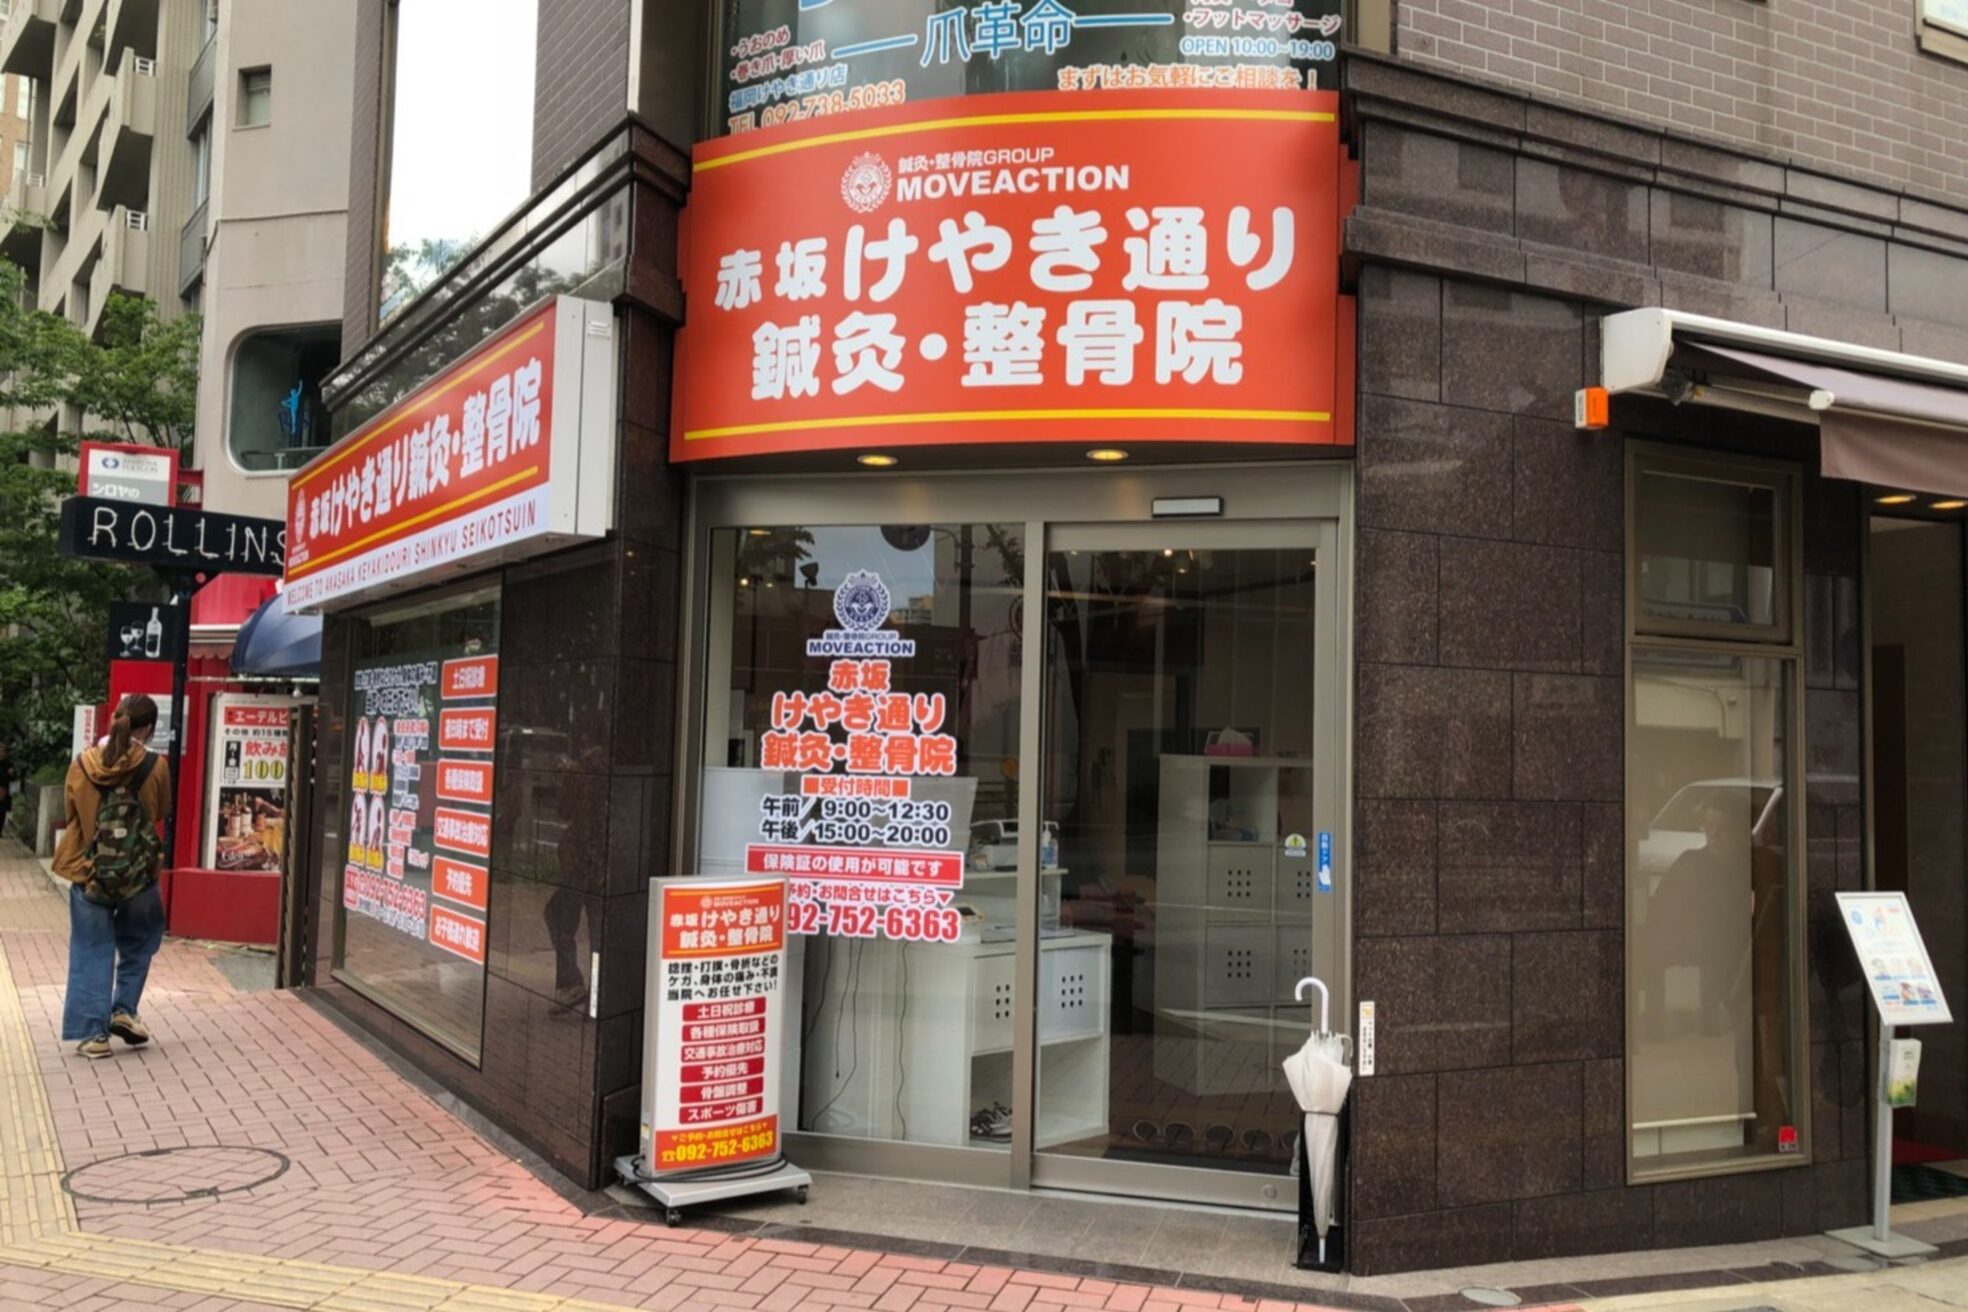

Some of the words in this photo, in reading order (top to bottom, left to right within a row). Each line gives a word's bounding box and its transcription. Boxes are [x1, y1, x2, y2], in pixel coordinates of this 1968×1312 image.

[919, 0, 1074, 67] 爪革命
[1180, 37, 1229, 55] OPEN
[897, 165, 1130, 202] MOVEACTION
[714, 205, 1296, 311] 赤坂けやき通り
[750, 298, 1244, 401] 鍼灸・整骨院
[414, 532, 457, 564] SHINKYU
[462, 499, 536, 549] SEIKOTSUIN
[809, 641, 913, 655] MOVEACTION
[830, 660, 890, 691] 赤坂
[773, 692, 945, 733] けやき通り
[763, 733, 954, 773] 鍼灸・整骨院
[764, 852, 943, 876] 保険証の使用が可能です
[701, 1062, 748, 1080] 予約優先
